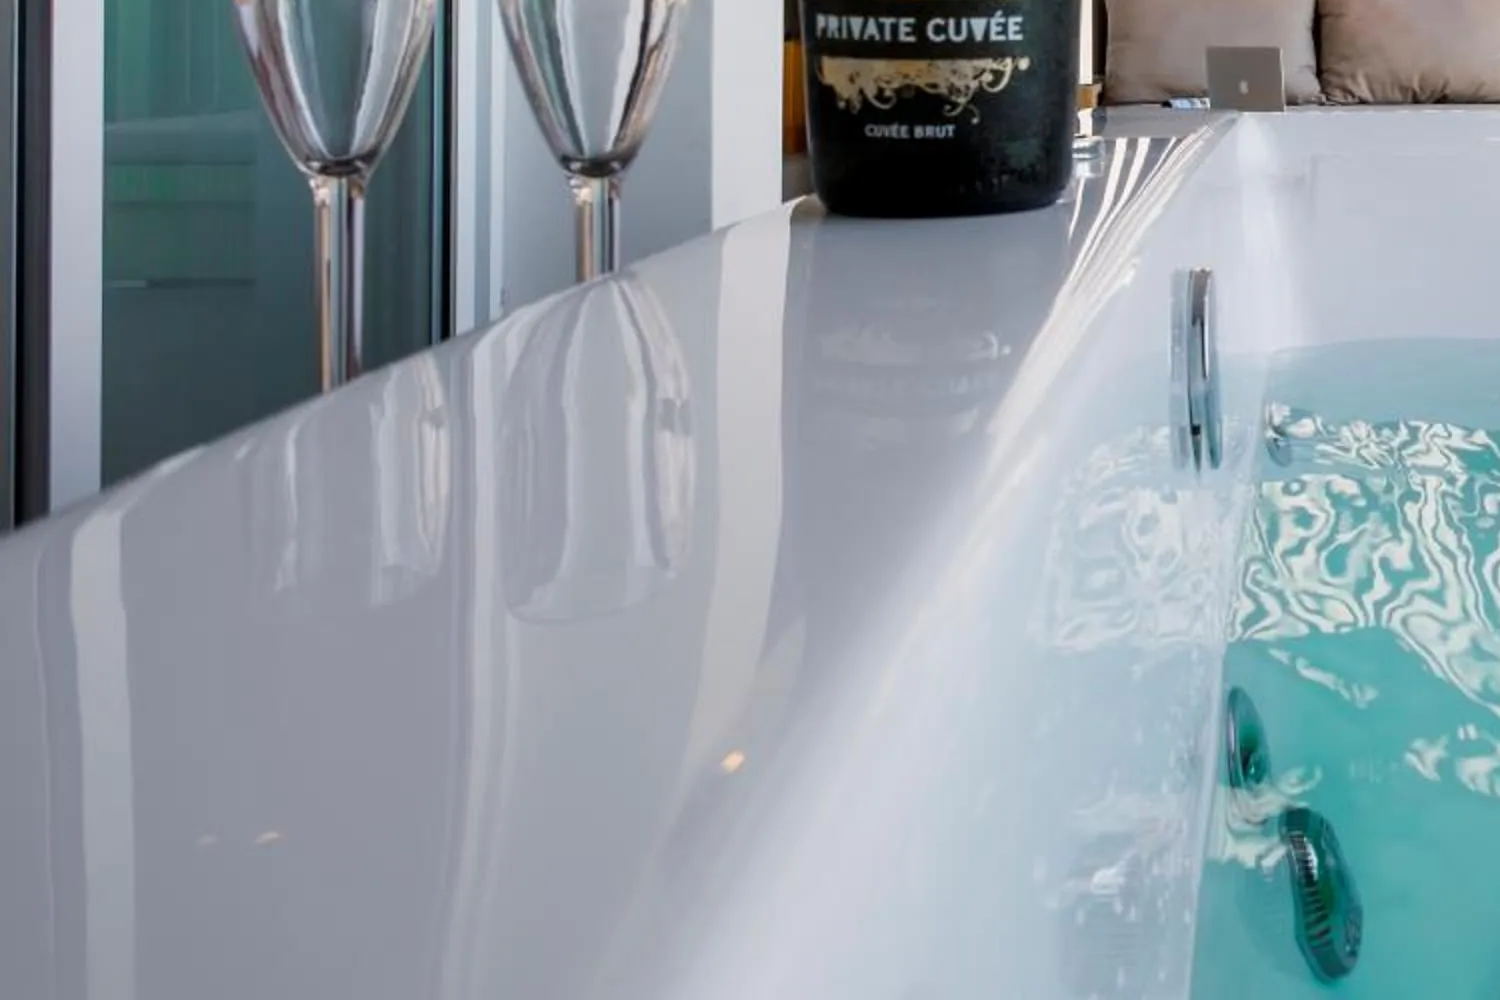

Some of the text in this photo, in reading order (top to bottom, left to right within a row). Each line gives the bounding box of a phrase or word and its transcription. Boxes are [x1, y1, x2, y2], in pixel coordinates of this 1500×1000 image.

[815, 10, 1024, 43] PRIVATE CUVÉE
[913, 124, 956, 138] BRUT
